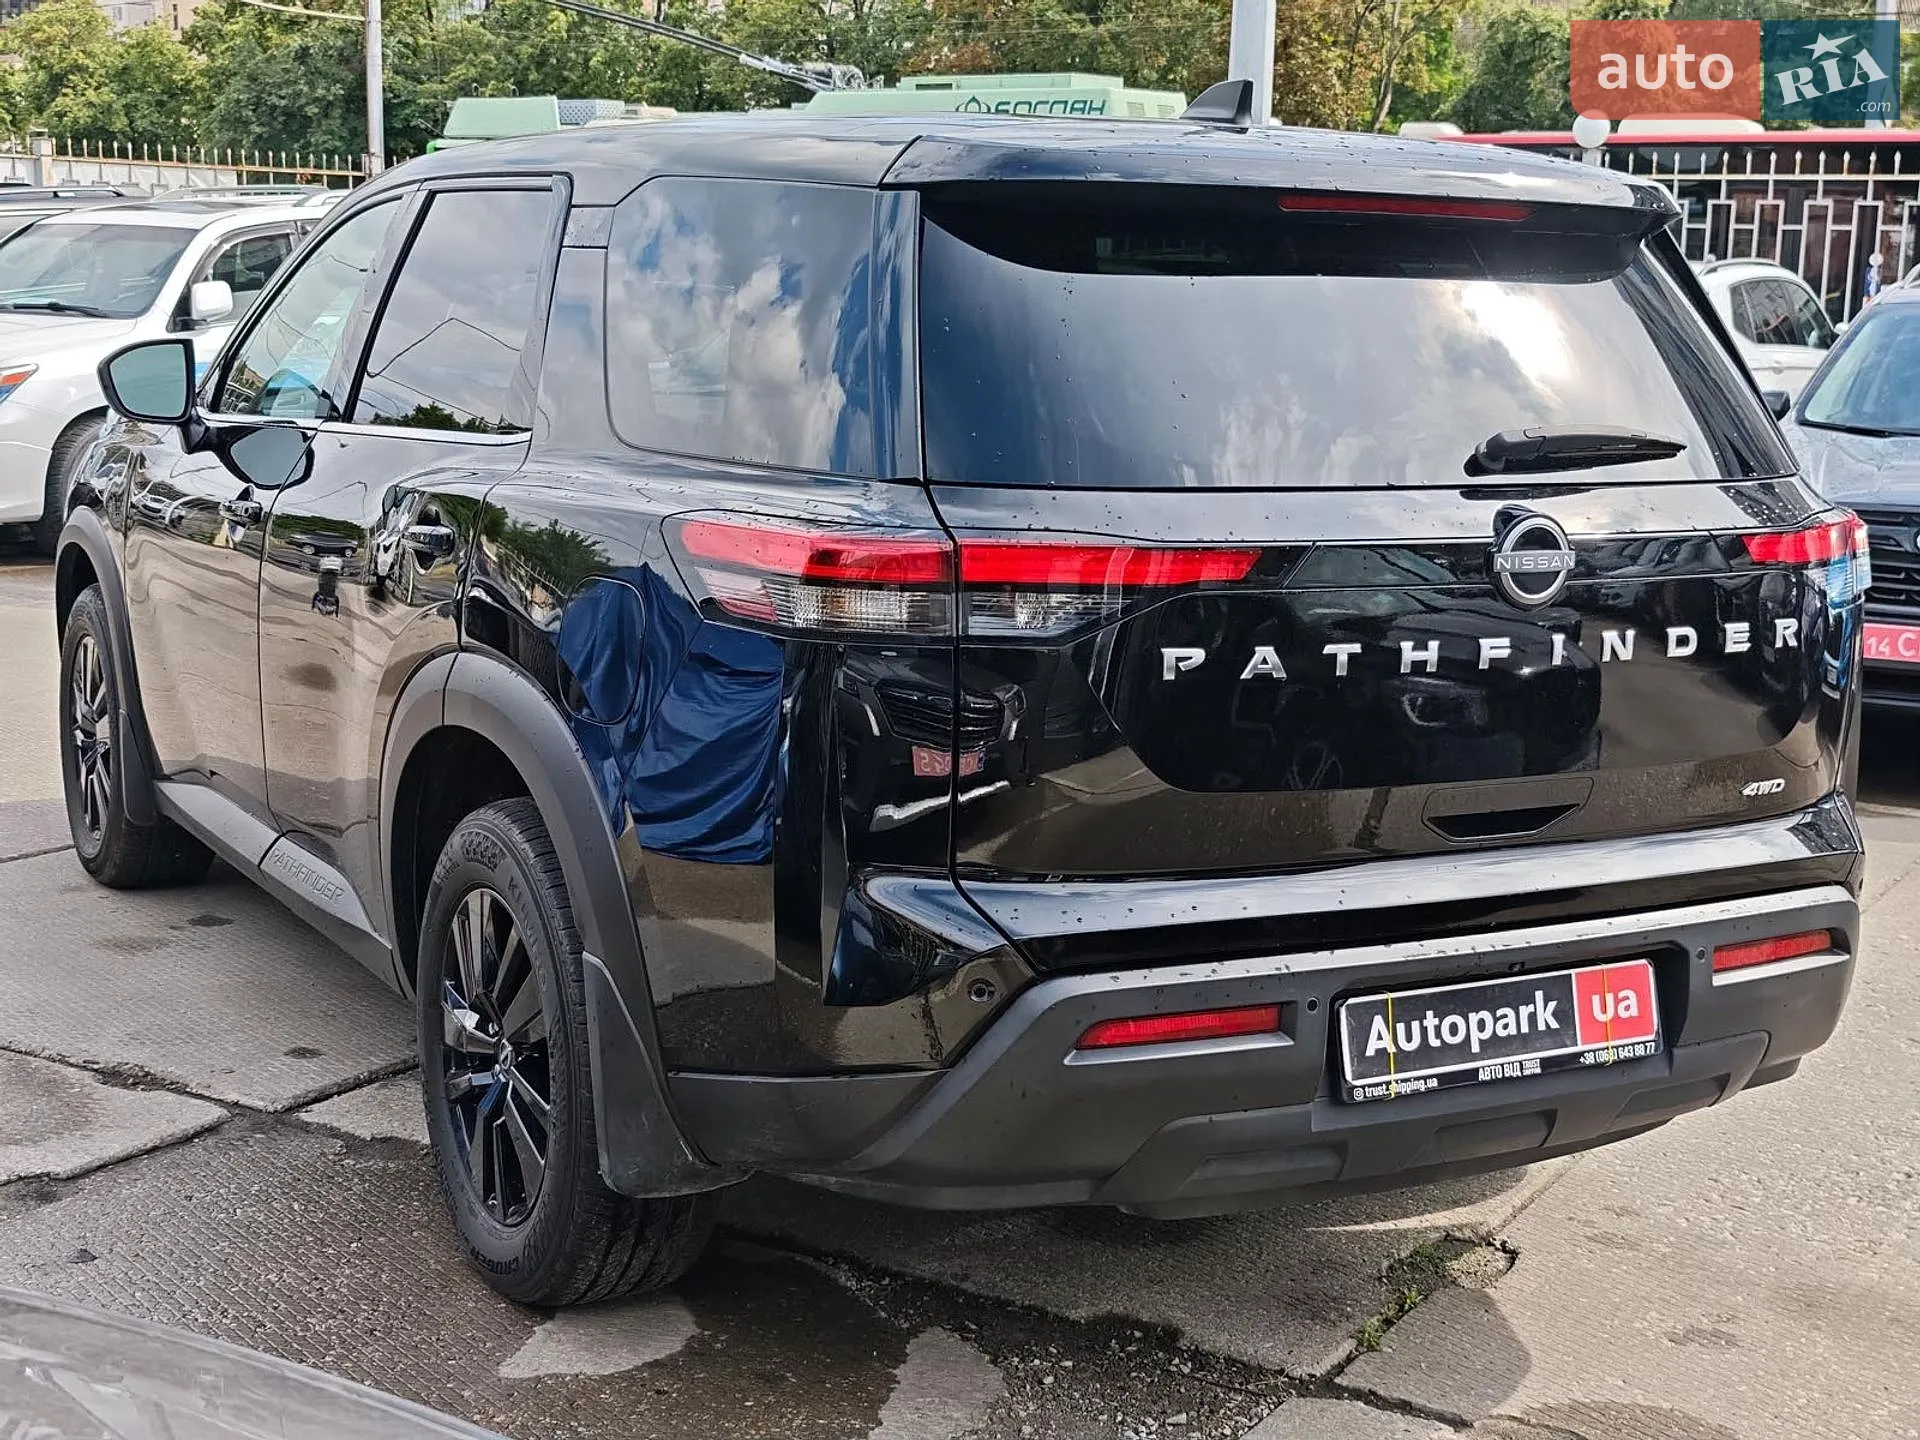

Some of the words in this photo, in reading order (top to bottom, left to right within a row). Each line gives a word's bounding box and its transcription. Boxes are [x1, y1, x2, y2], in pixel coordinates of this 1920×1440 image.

[1496, 555, 1574, 570] NISSAN
[1161, 617, 1800, 682] PATHFINDER
[1867, 636, 1891, 657] 14
[1742, 778, 1786, 796] 4WD
[1365, 990, 1560, 1057] Autopark
[1591, 988, 1640, 1023] ua
[1618, 1045, 1634, 1059] 643
[1645, 1041, 1656, 1054] 77
[1478, 1065, 1503, 1081] АВТО
[1503, 1061, 1522, 1078] ВІД
